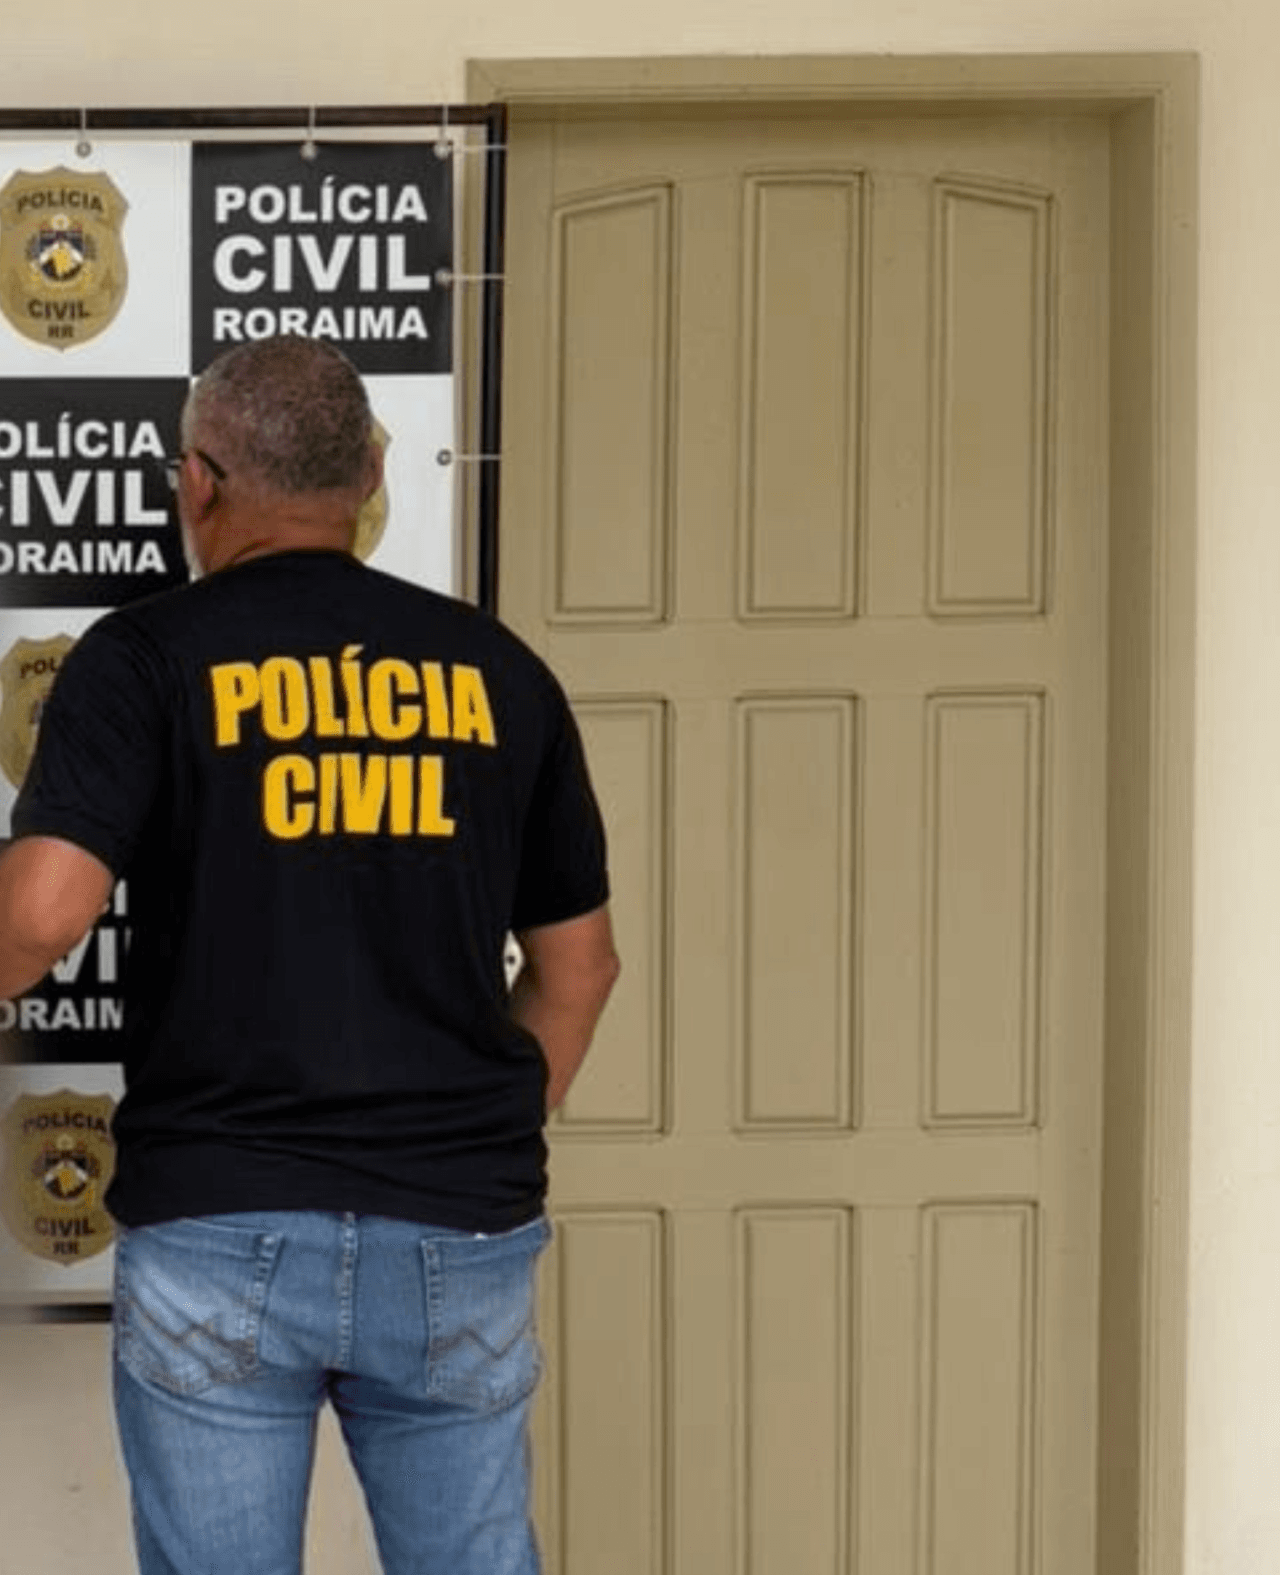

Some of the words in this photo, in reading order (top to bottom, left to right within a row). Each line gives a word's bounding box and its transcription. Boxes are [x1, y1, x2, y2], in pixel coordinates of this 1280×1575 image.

[215, 176, 428, 223] POLÍCIA
[213, 234, 431, 293] CIVIL
[28, 299, 90, 320] CIVIL
[213, 306, 428, 341] RORAIMA
[209, 643, 497, 747] POLÍCIA
[262, 752, 456, 840] CIVIL
[34, 1216, 96, 1237] CIVIL
